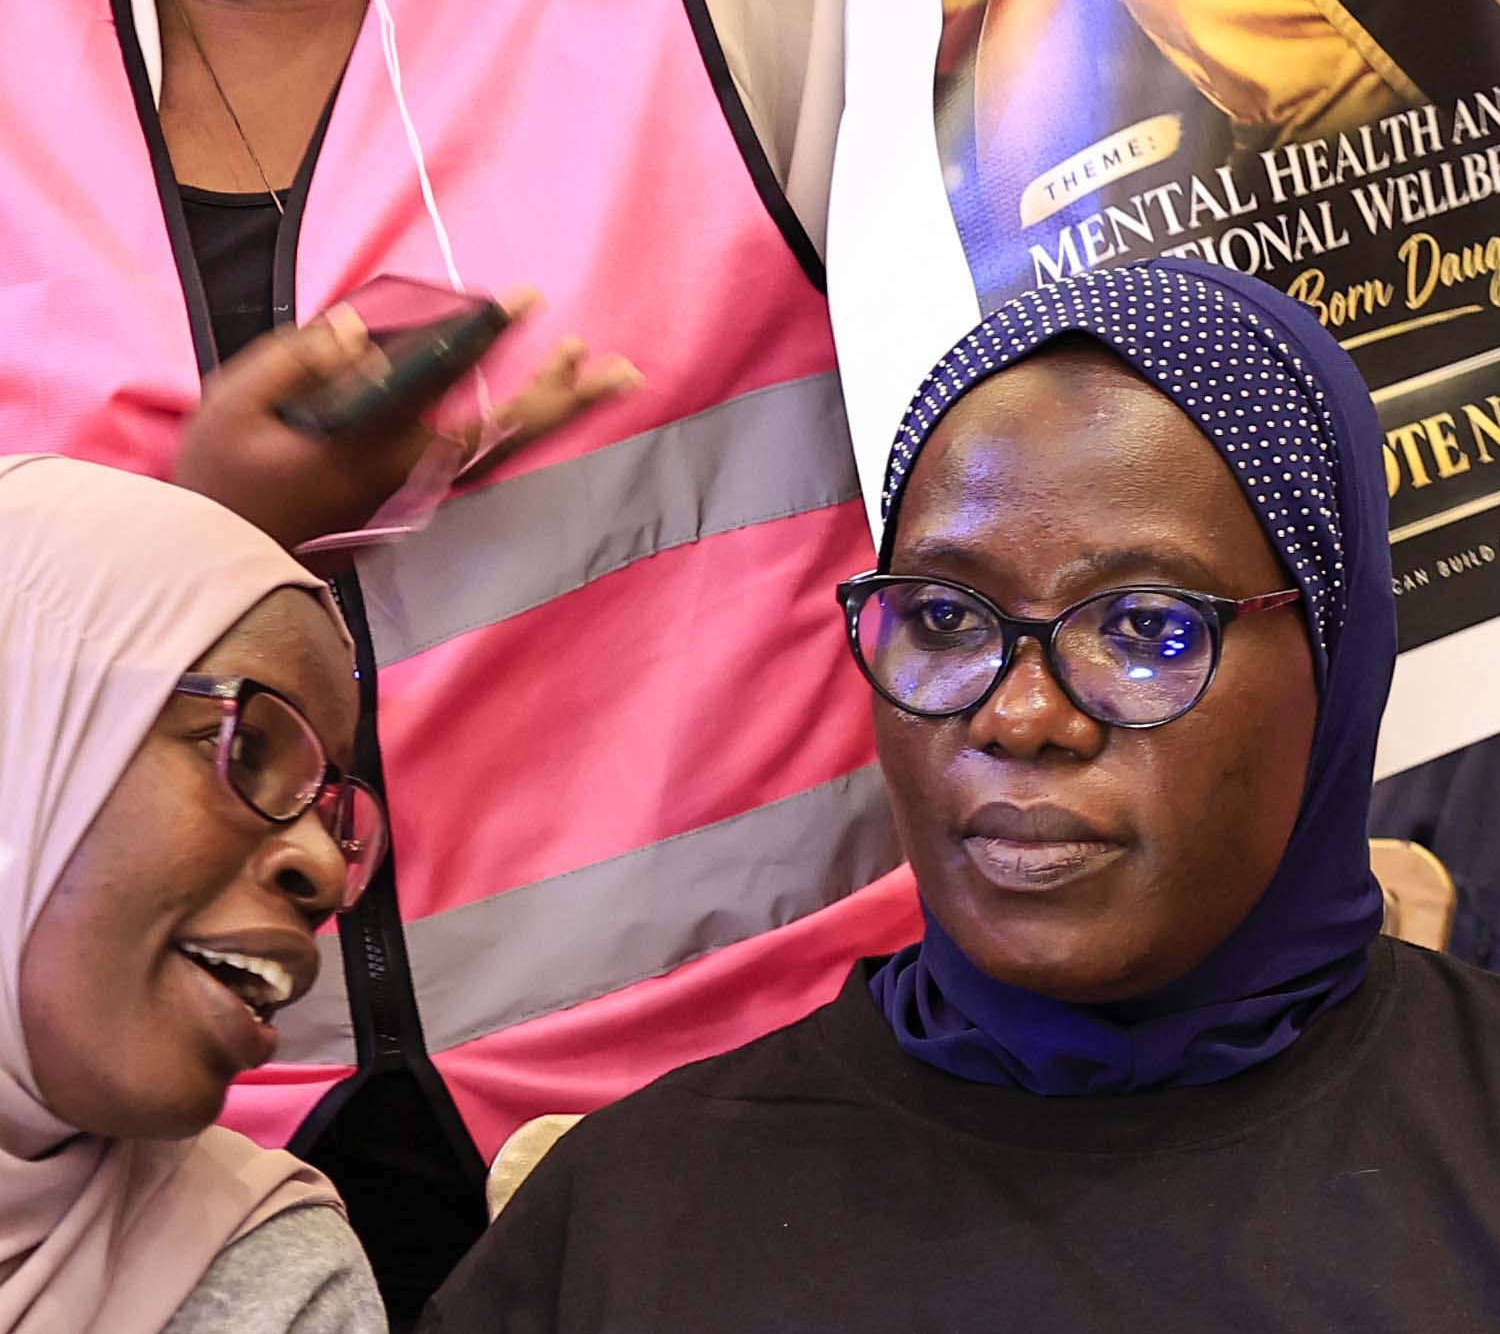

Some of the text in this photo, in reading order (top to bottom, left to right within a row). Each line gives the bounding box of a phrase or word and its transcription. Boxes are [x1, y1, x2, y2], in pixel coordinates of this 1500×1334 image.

[1028, 164, 1258, 289] MENTAL
[1259, 103, 1442, 204] HEALTH
[1044, 133, 1159, 201] THEME:
[1158, 201, 1350, 277] TIONAL
[1287, 268, 1394, 327] Born
[1436, 543, 1495, 579] BUILD
